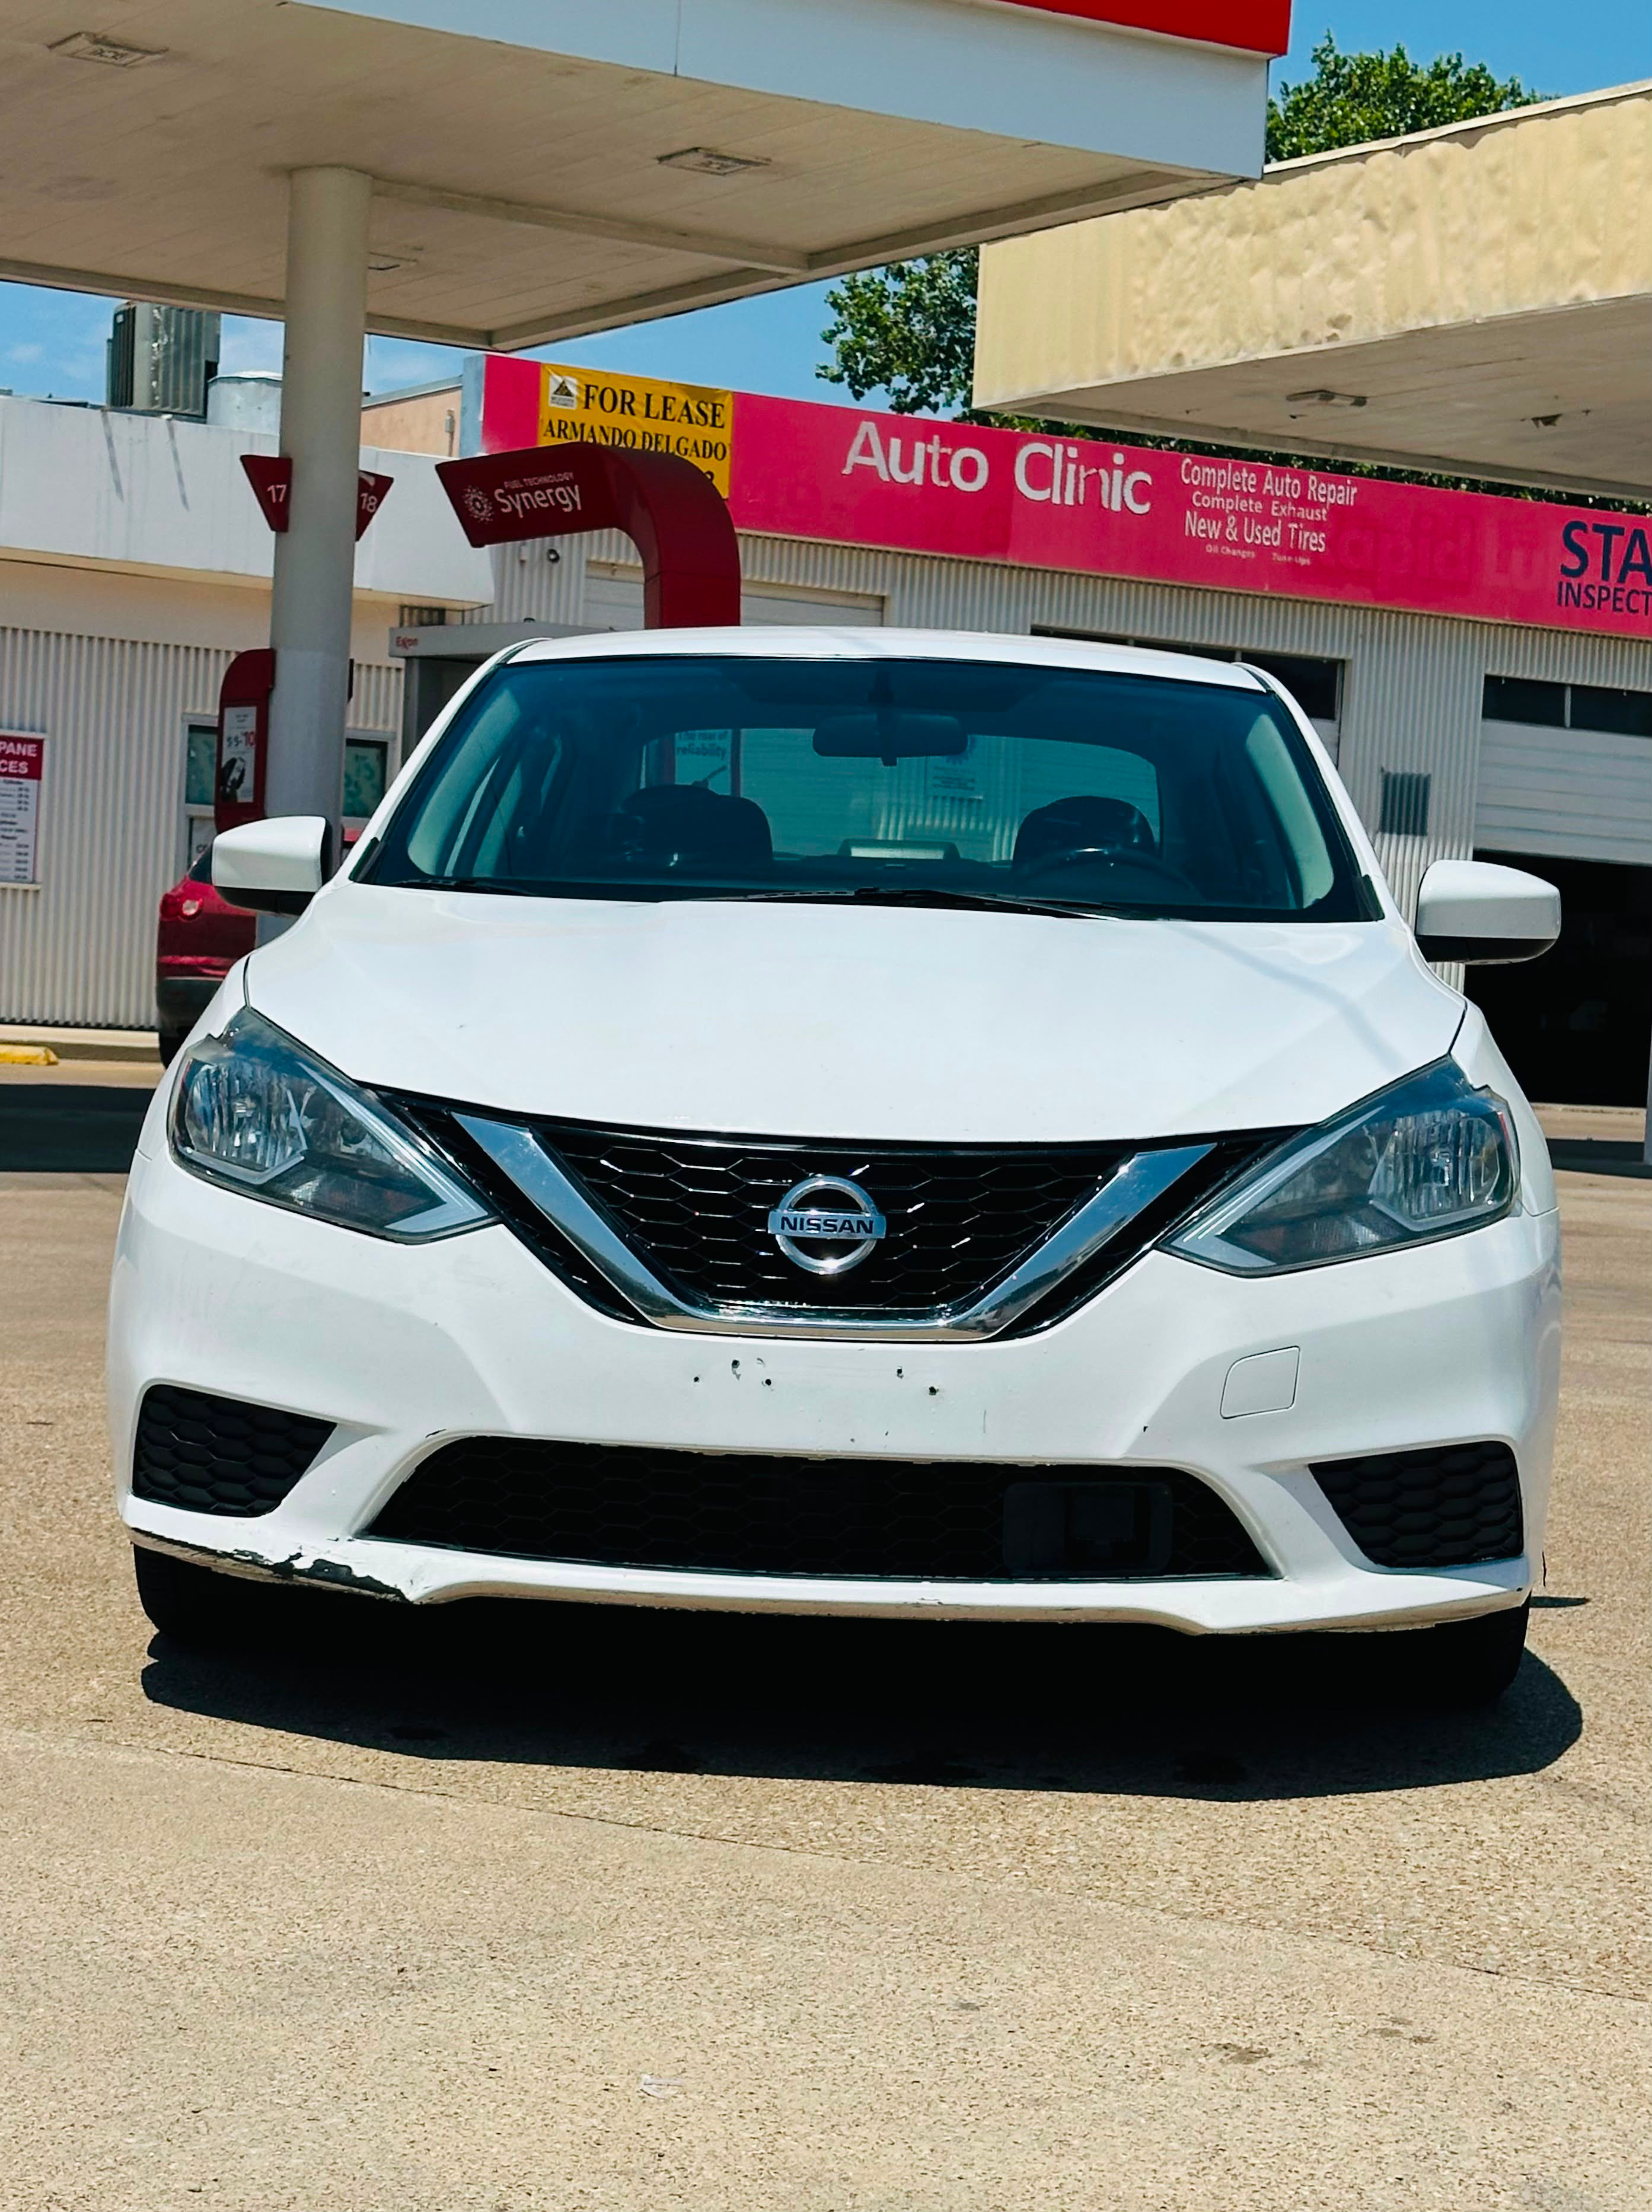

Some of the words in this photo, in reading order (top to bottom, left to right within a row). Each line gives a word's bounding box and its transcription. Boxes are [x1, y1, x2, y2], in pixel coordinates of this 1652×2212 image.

[584, 384, 636, 415] FOR
[645, 393, 726, 429] LEASE
[543, 418, 637, 449] ARMANDO
[642, 431, 728, 461] DELGADO
[841, 421, 989, 492] Auto
[1015, 442, 1152, 514] Clinic
[1181, 457, 1257, 495] Complete
[1262, 470, 1300, 499] Auto
[1308, 474, 1358, 506] Repair
[267, 485, 287, 503] 17
[360, 493, 378, 513] 18
[494, 485, 582, 518] Synergy
[1192, 490, 1262, 514] Complete
[1271, 500, 1328, 522] Exhaust
[1185, 510, 1223, 540] New
[1225, 515, 1238, 542] &
[1244, 517, 1281, 547] Used
[1287, 524, 1326, 553] Tires
[1205, 544, 1219, 554] Oil
[1557, 581, 1652, 616] INSPECT
[780, 1216, 874, 1234] NISSAN
